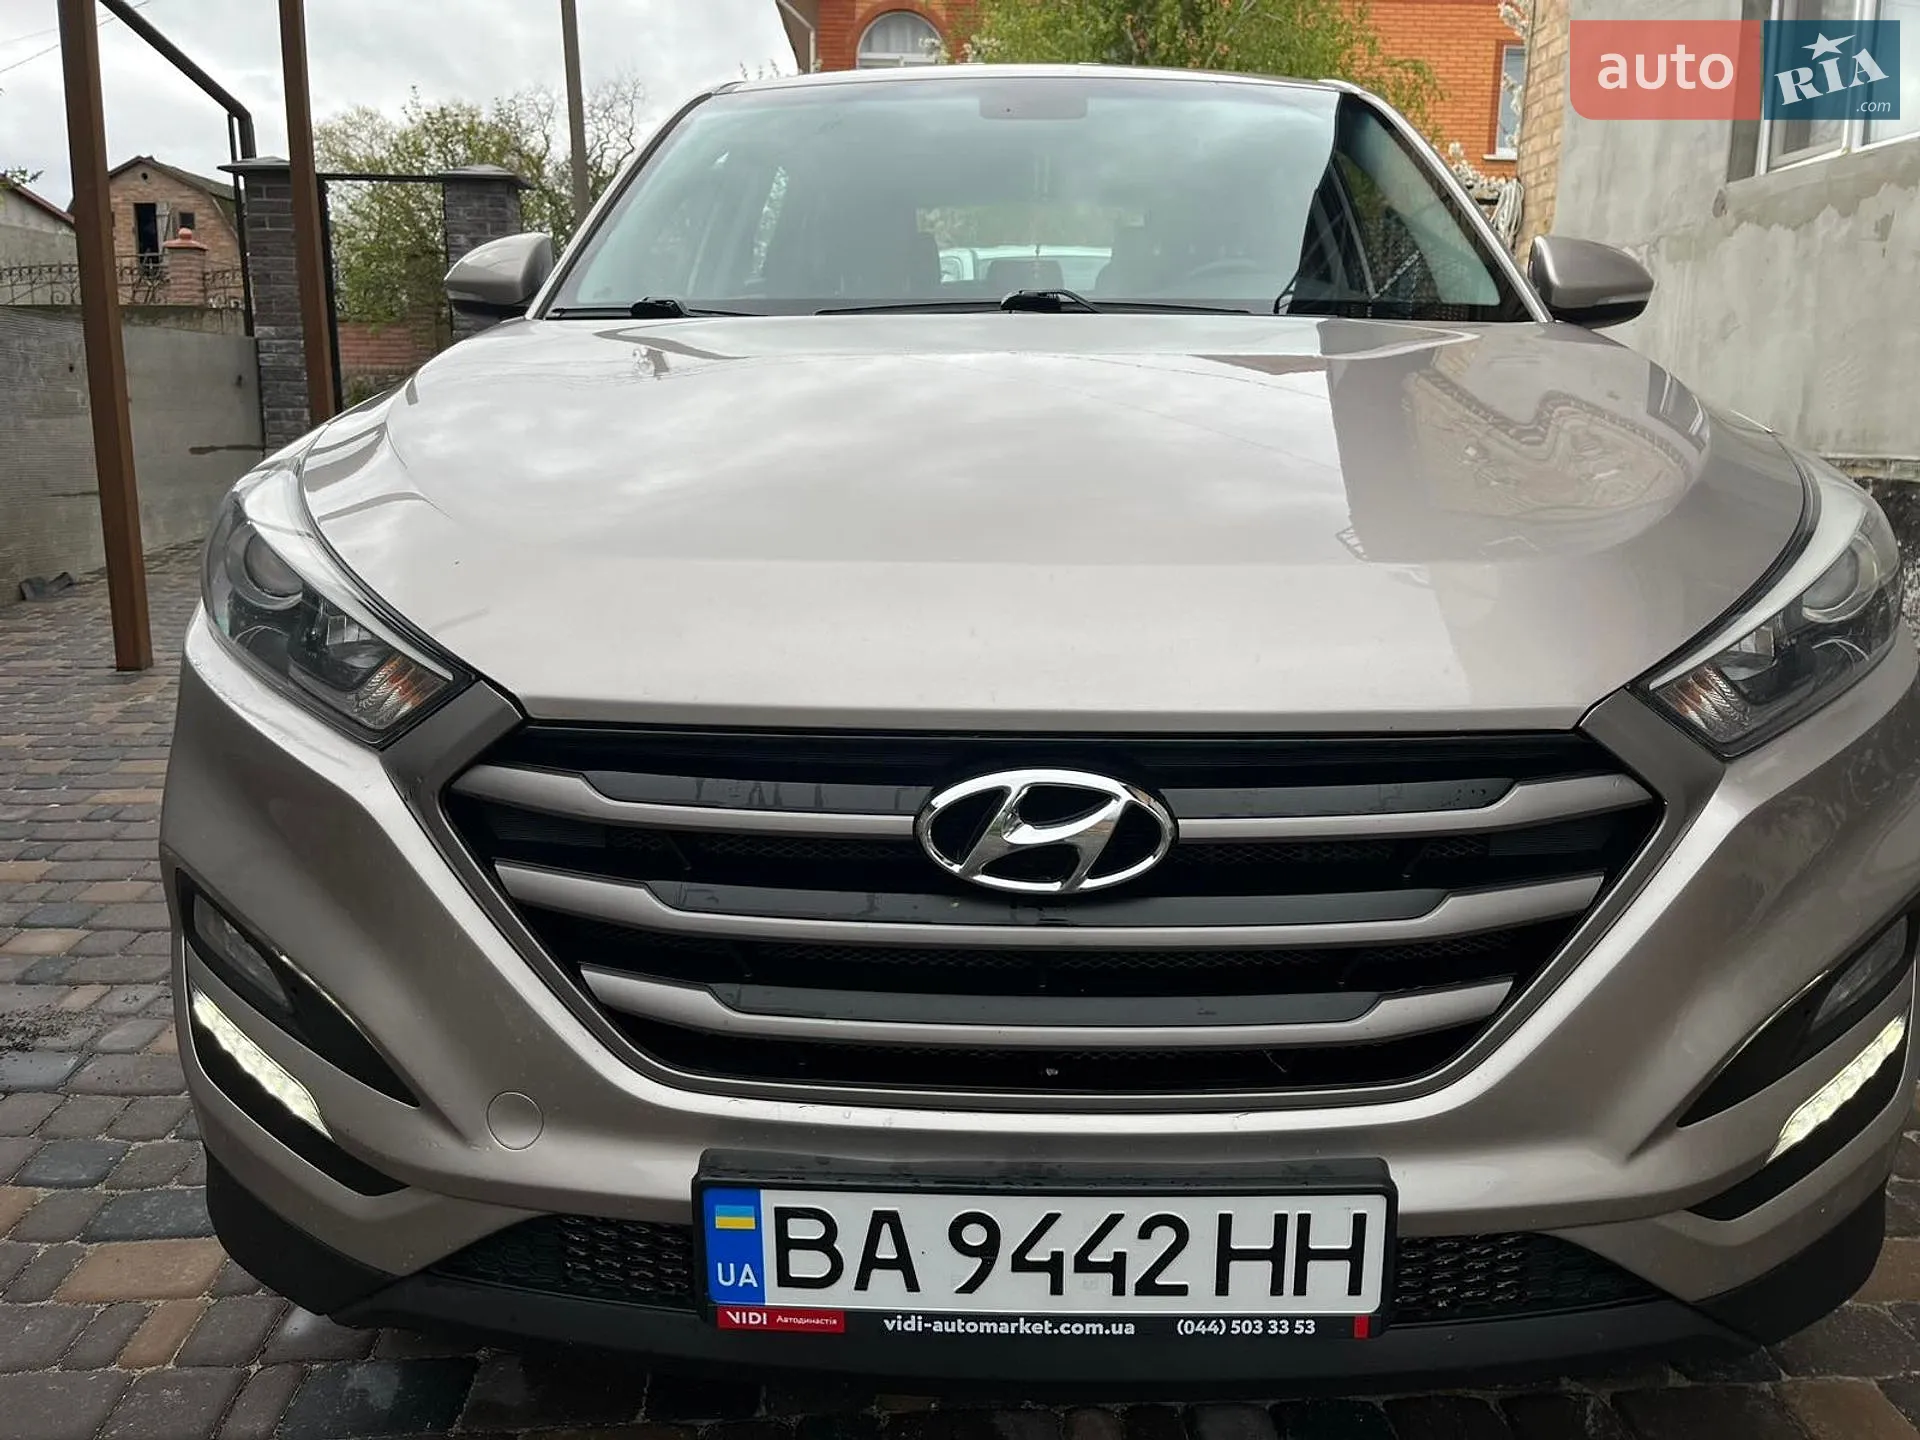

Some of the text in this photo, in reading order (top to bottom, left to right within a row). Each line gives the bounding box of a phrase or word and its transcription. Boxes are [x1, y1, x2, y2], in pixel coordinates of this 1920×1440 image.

[773, 1206, 1368, 1296] BA 9442 HH
[716, 1262, 759, 1288] UA
[726, 1310, 768, 1325] VIDI
[883, 1315, 1135, 1336] vidi-automarket.com.ua
[1176, 1319, 1316, 1336] (044) 503 33 53
